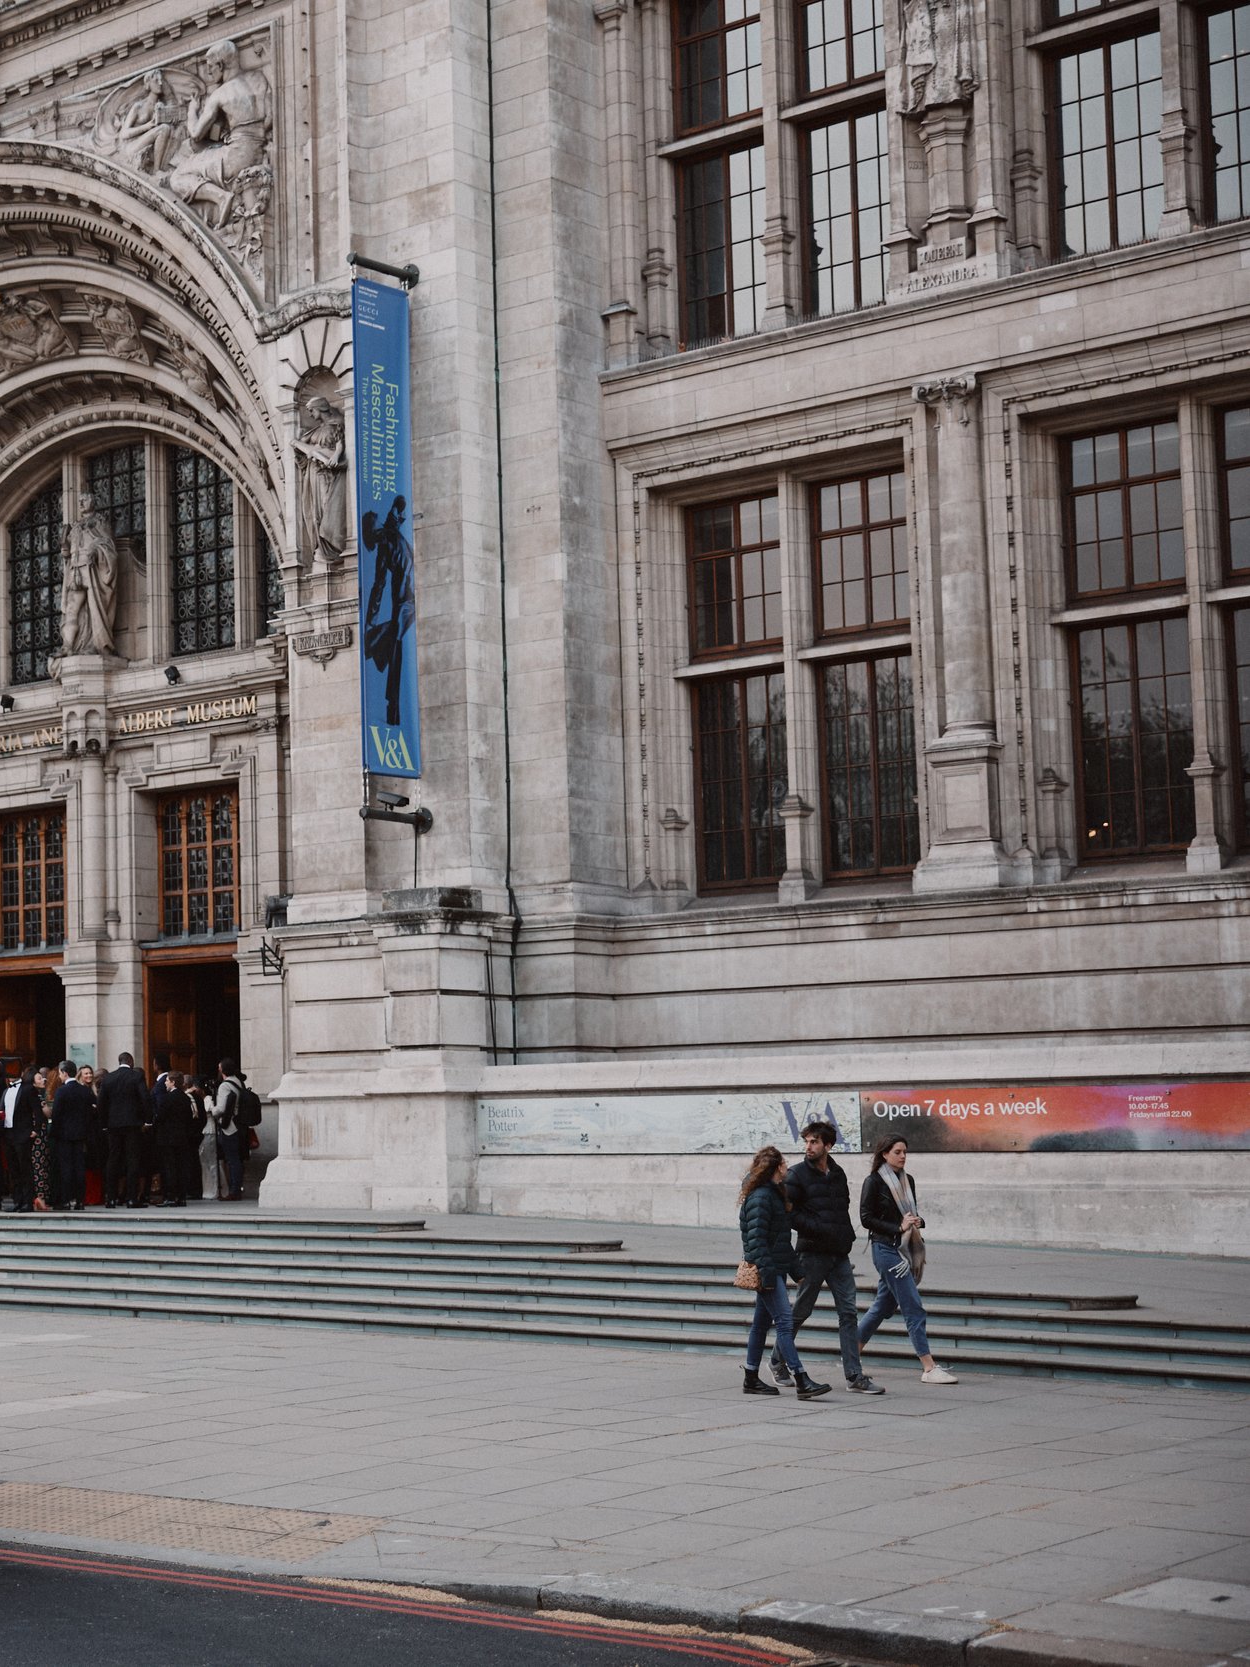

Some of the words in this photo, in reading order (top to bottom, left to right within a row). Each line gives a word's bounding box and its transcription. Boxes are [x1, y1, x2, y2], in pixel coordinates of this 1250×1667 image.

[906, 265, 979, 294] ALEXANDRA
[358, 305, 379, 316] GUCCI
[371, 363, 385, 501] Masculinities
[383, 382, 399, 494] Fashioning
[118, 708, 176, 734] ALBERT
[186, 695, 257, 724] MUSEUM
[368, 725, 416, 771] V&A
[487, 1106, 525, 1118] Beatrix
[873, 1100, 921, 1121] Open
[924, 1099, 935, 1117] 7
[938, 1098, 980, 1120] days
[984, 1101, 994, 1116] a
[998, 1097, 1048, 1115] week
[1171, 1110, 1192, 1118] 22.00
[487, 1119, 518, 1132] Potter
